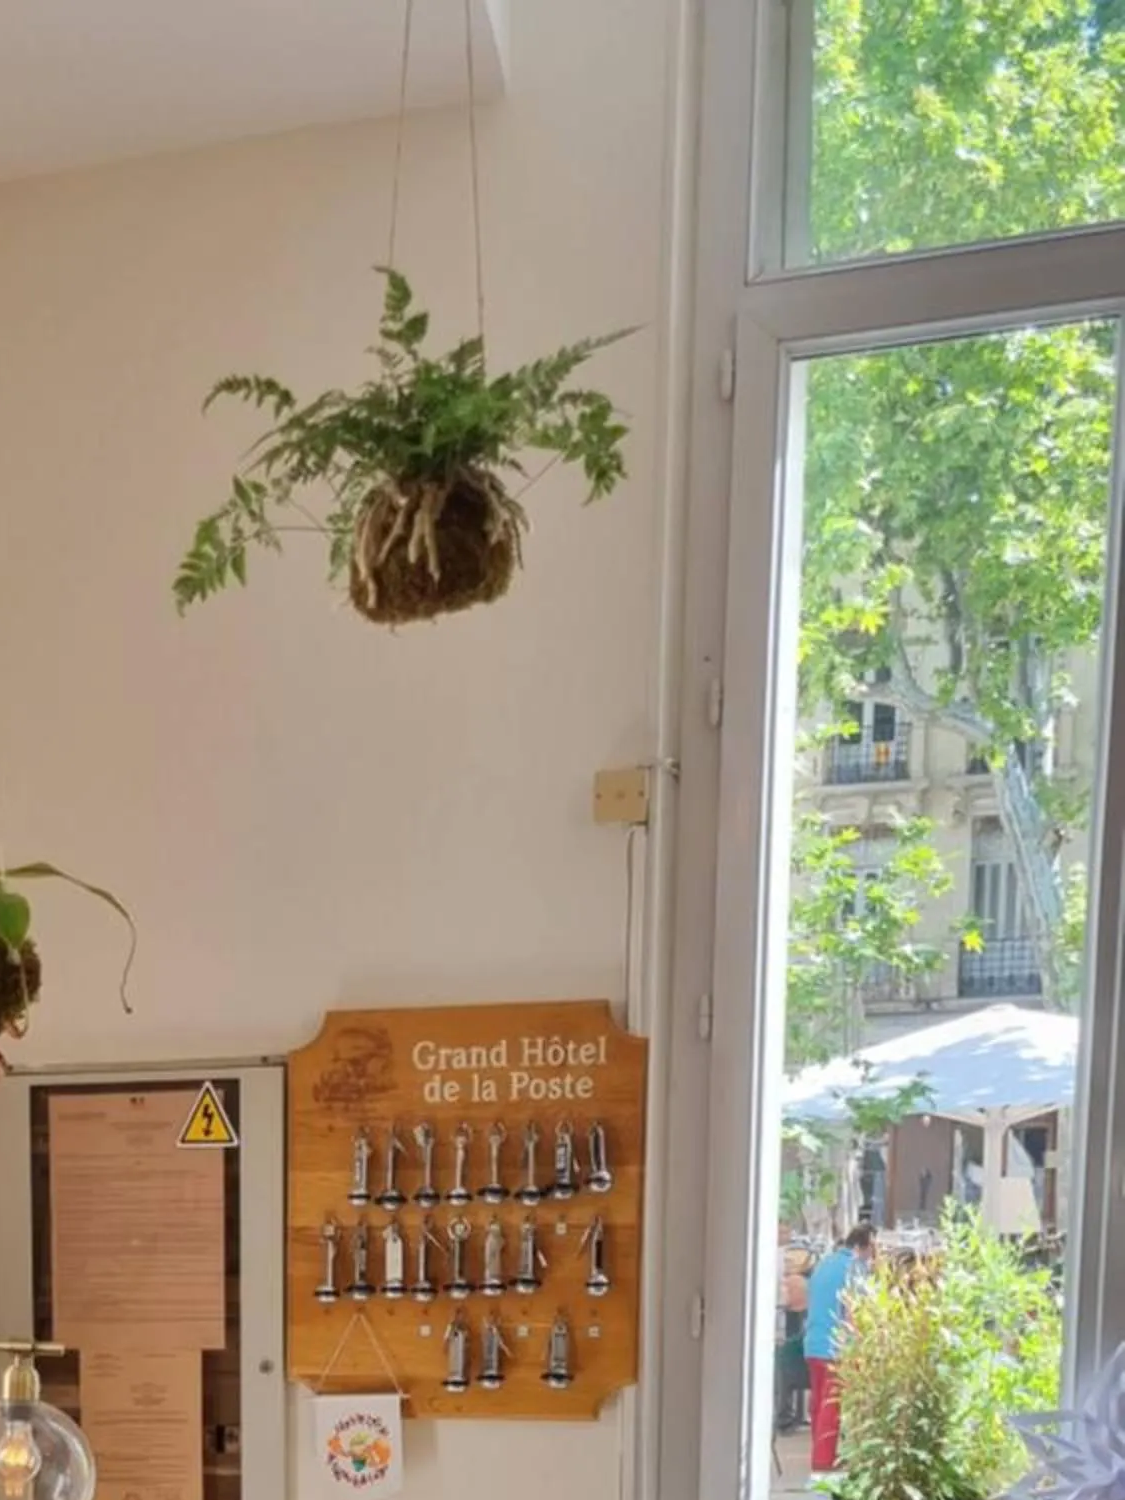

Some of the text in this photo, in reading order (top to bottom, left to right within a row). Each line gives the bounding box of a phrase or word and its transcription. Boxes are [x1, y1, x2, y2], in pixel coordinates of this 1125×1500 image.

[412, 1035, 607, 1070] Grand Hôtel
[424, 1071, 594, 1102] de la Poste
